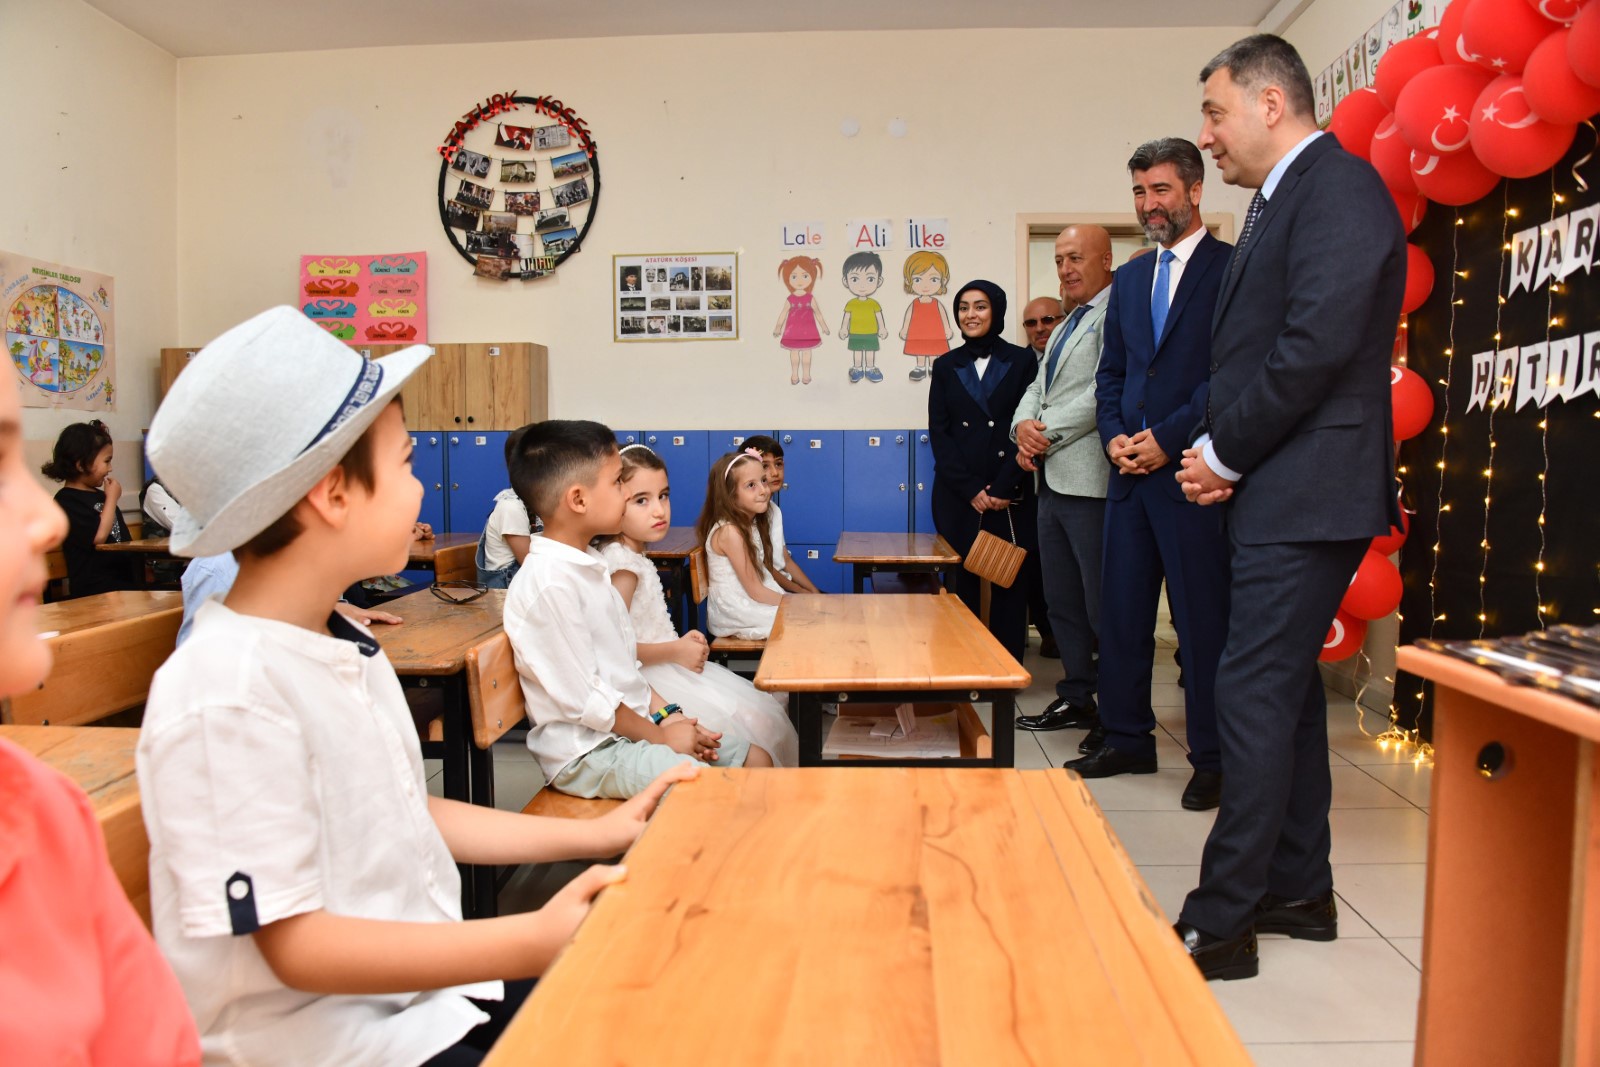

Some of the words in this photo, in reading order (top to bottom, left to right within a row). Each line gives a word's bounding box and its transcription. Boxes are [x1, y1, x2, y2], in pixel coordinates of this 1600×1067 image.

[783, 226, 822, 246] Lale
[856, 224, 886, 248] Ali
[909, 219, 945, 248] İlke
[1517, 218, 1594, 276] KAR
